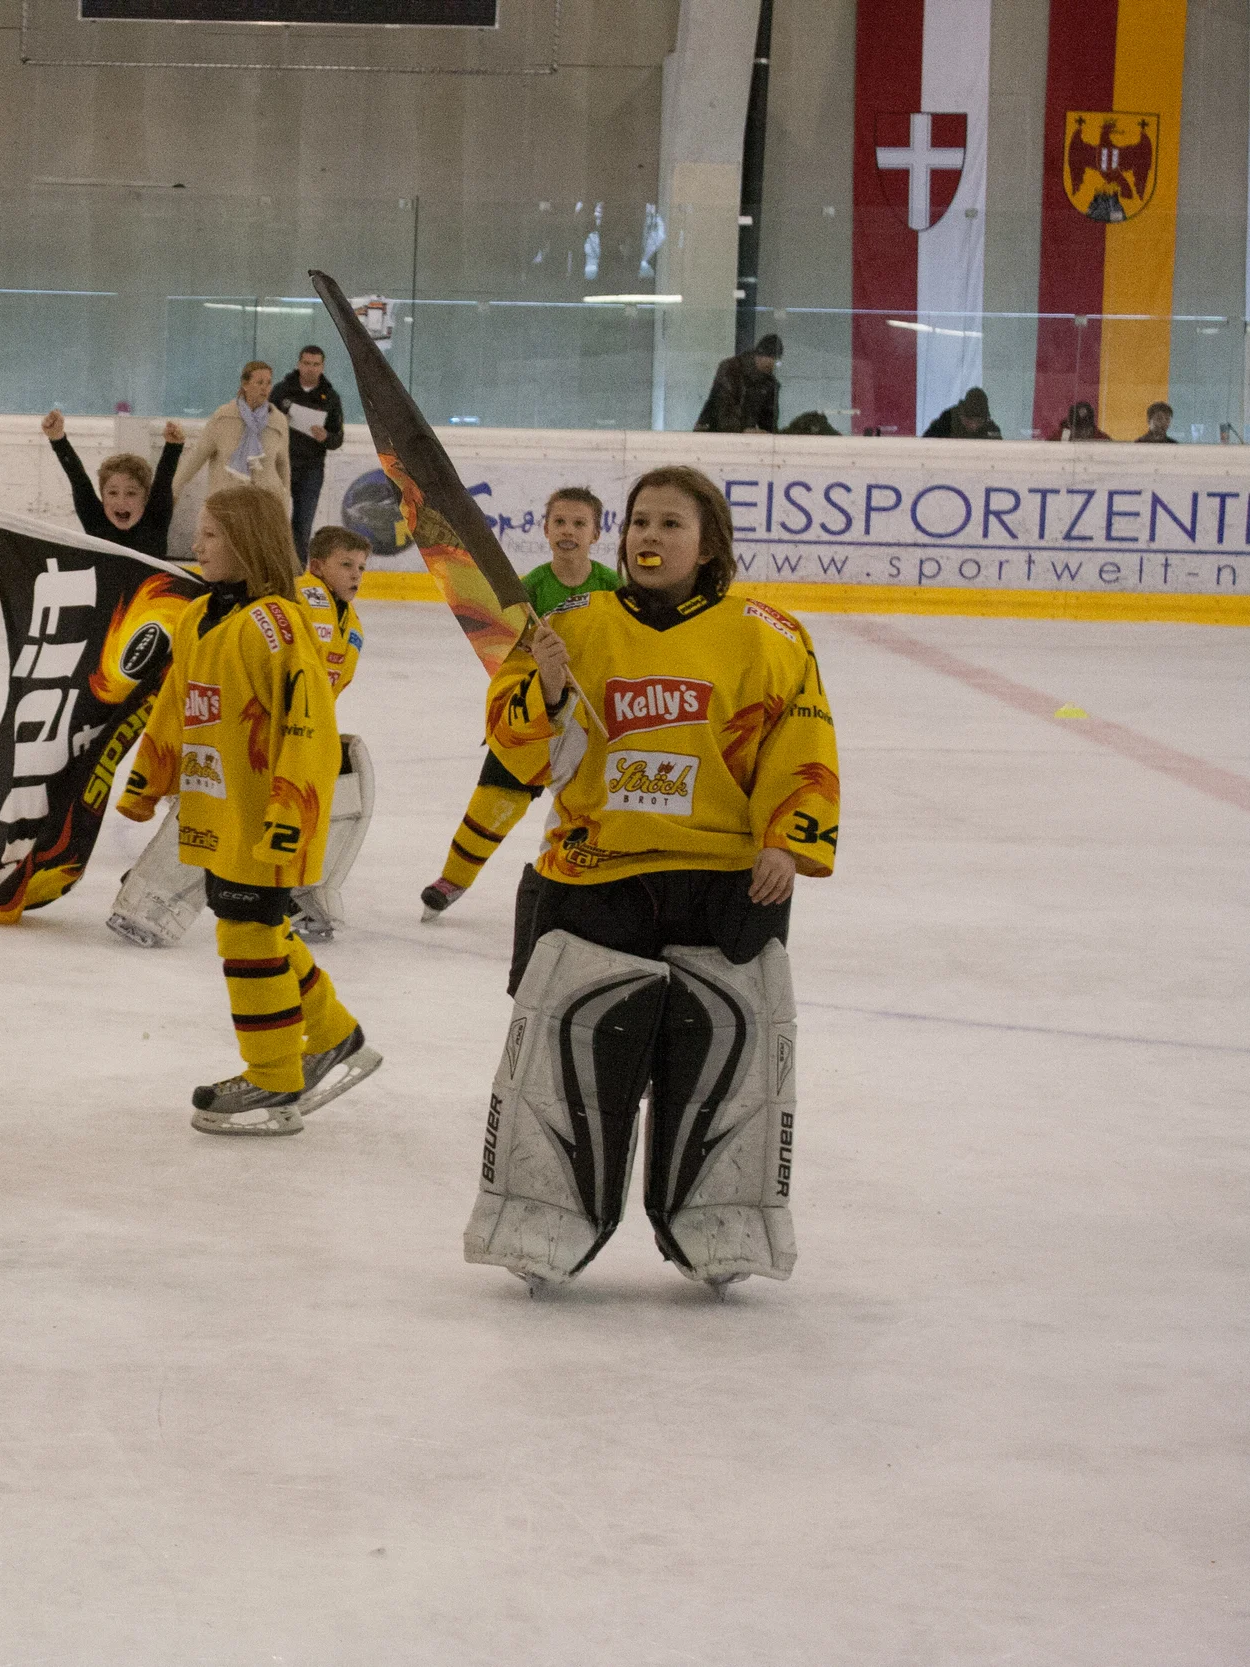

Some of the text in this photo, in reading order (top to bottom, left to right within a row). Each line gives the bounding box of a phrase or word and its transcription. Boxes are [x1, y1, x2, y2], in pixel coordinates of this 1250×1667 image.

[251, 608, 279, 651] RICOH
[614, 684, 699, 721] Kelly's
[609, 757, 692, 797] Ströck
[623, 794, 669, 806] BROT
